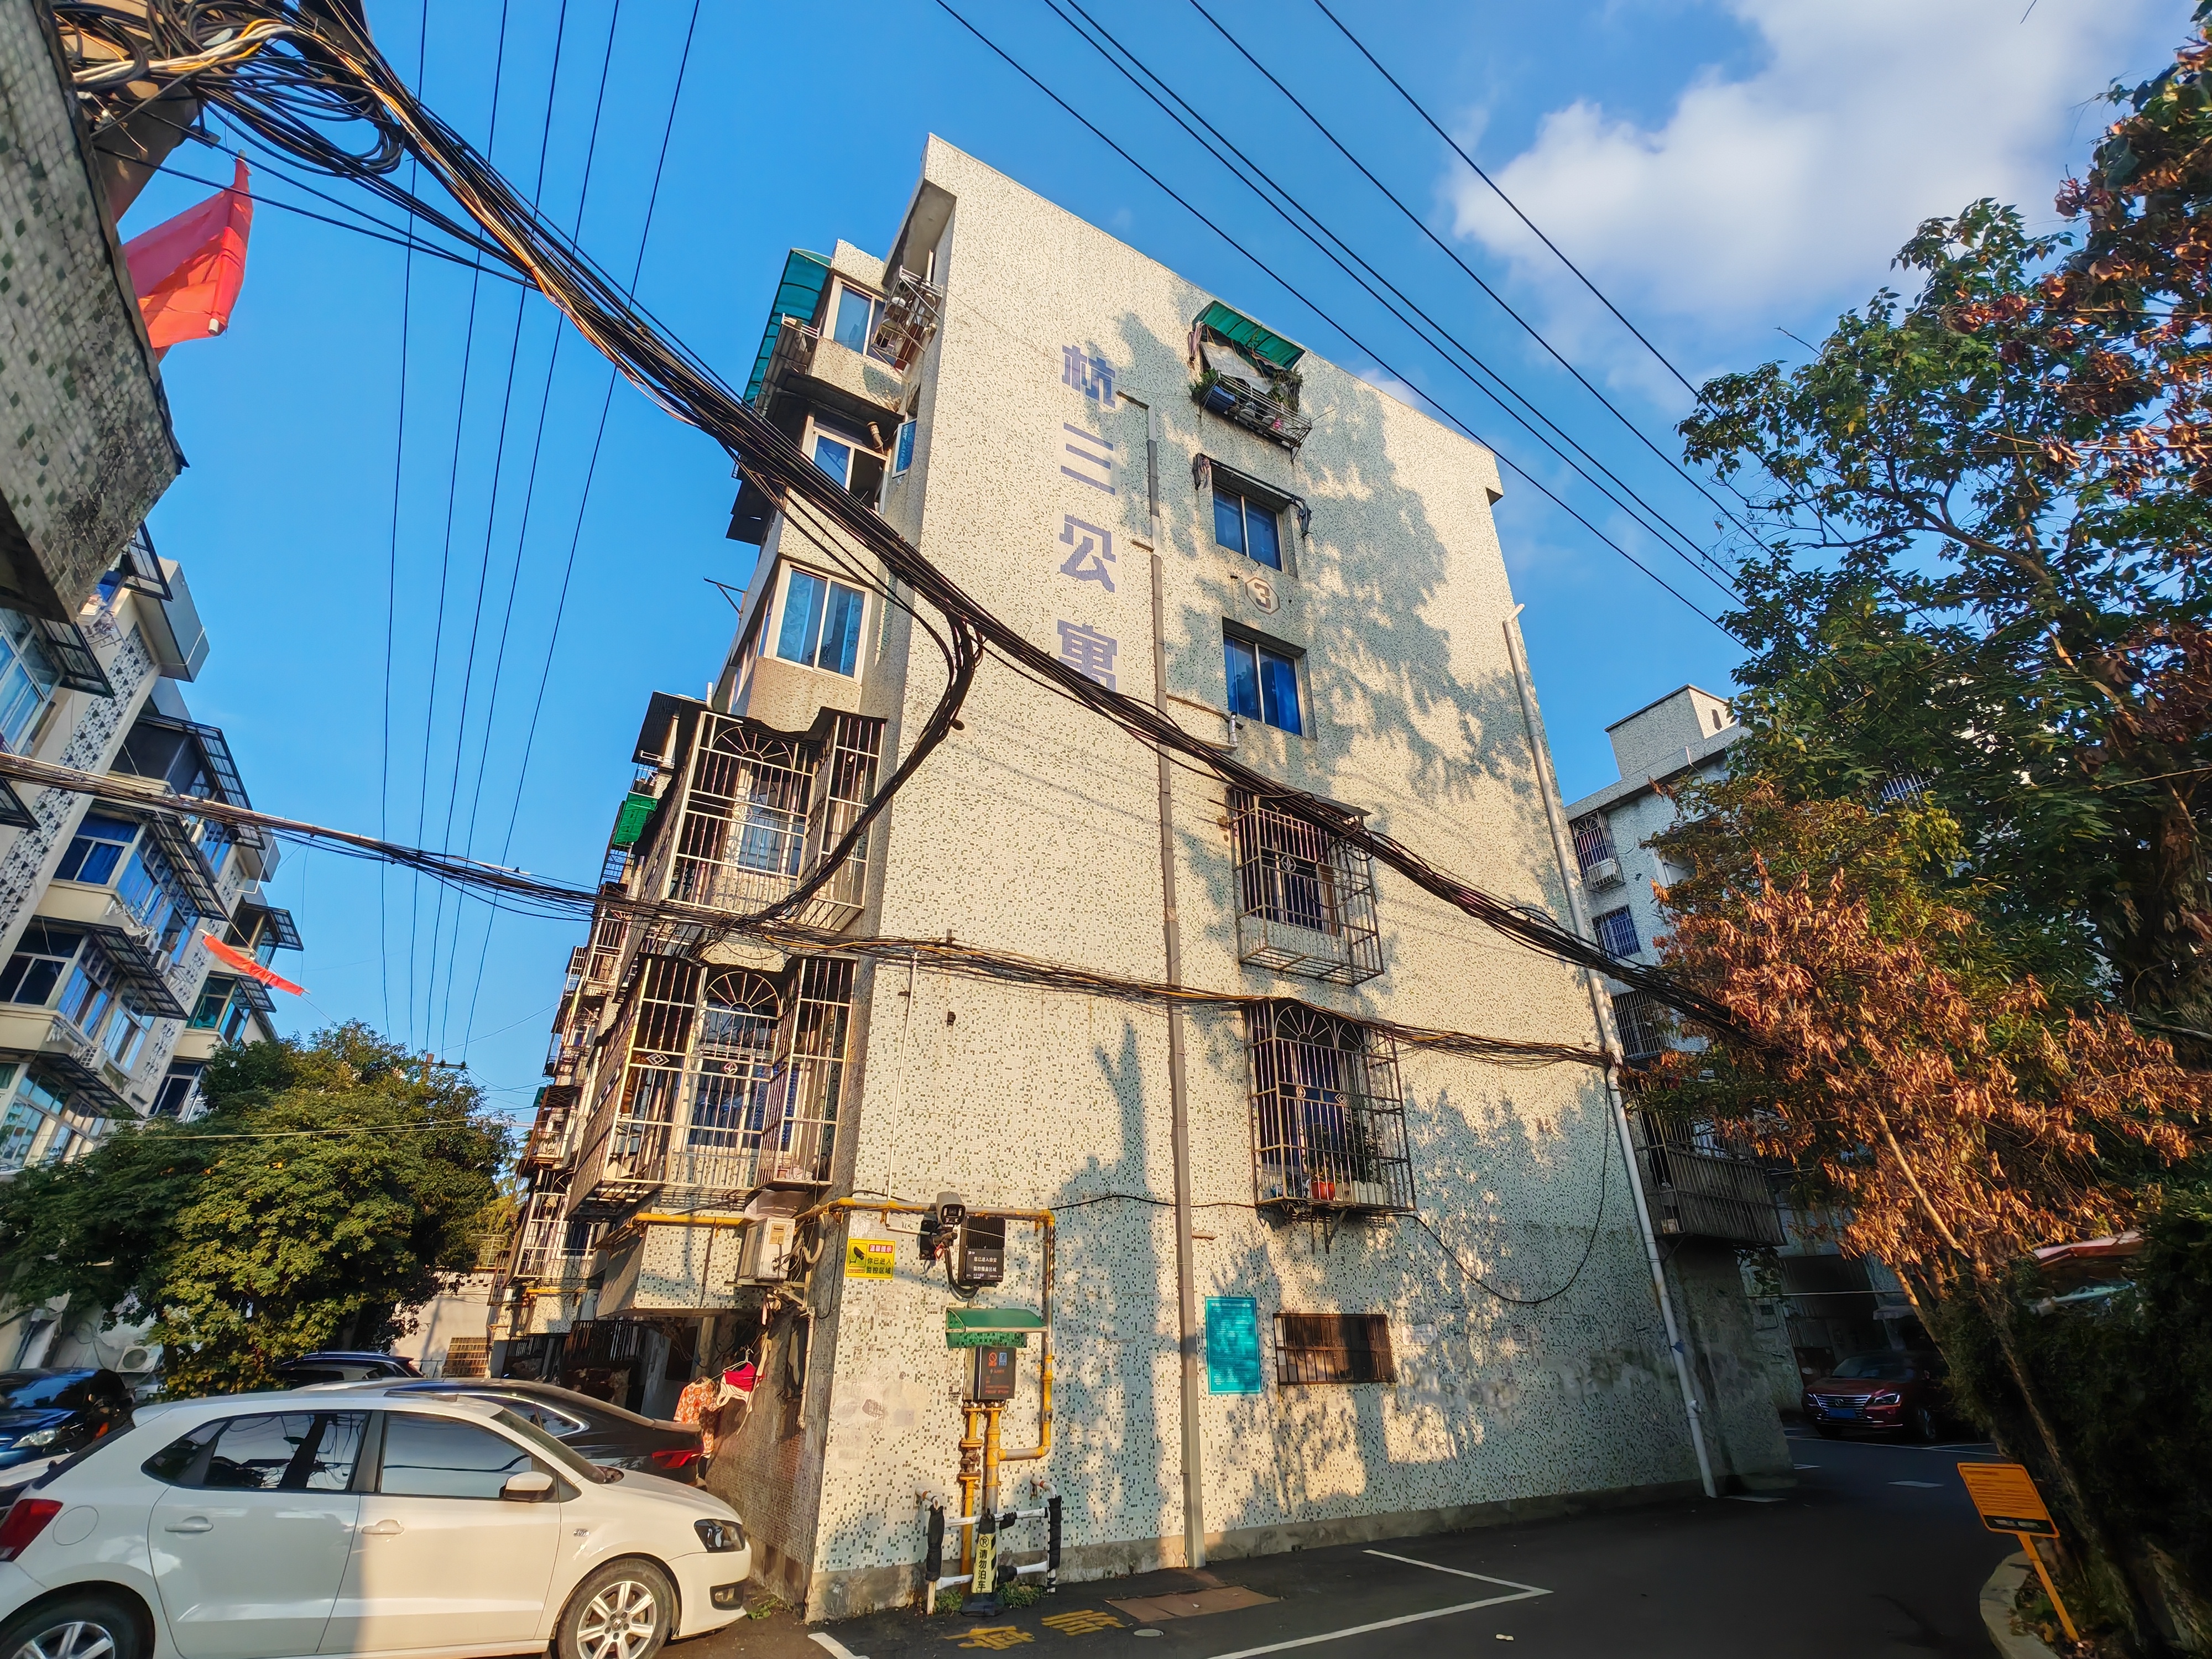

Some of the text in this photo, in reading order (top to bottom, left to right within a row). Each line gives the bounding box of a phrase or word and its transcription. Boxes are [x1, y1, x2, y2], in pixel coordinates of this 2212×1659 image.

[1057, 345, 1117, 691] 杭三公寓
[1254, 582, 1271, 609] 3
[866, 1266, 891, 1274] 监控区域
[977, 1550, 988, 1593] 请勿泊车
